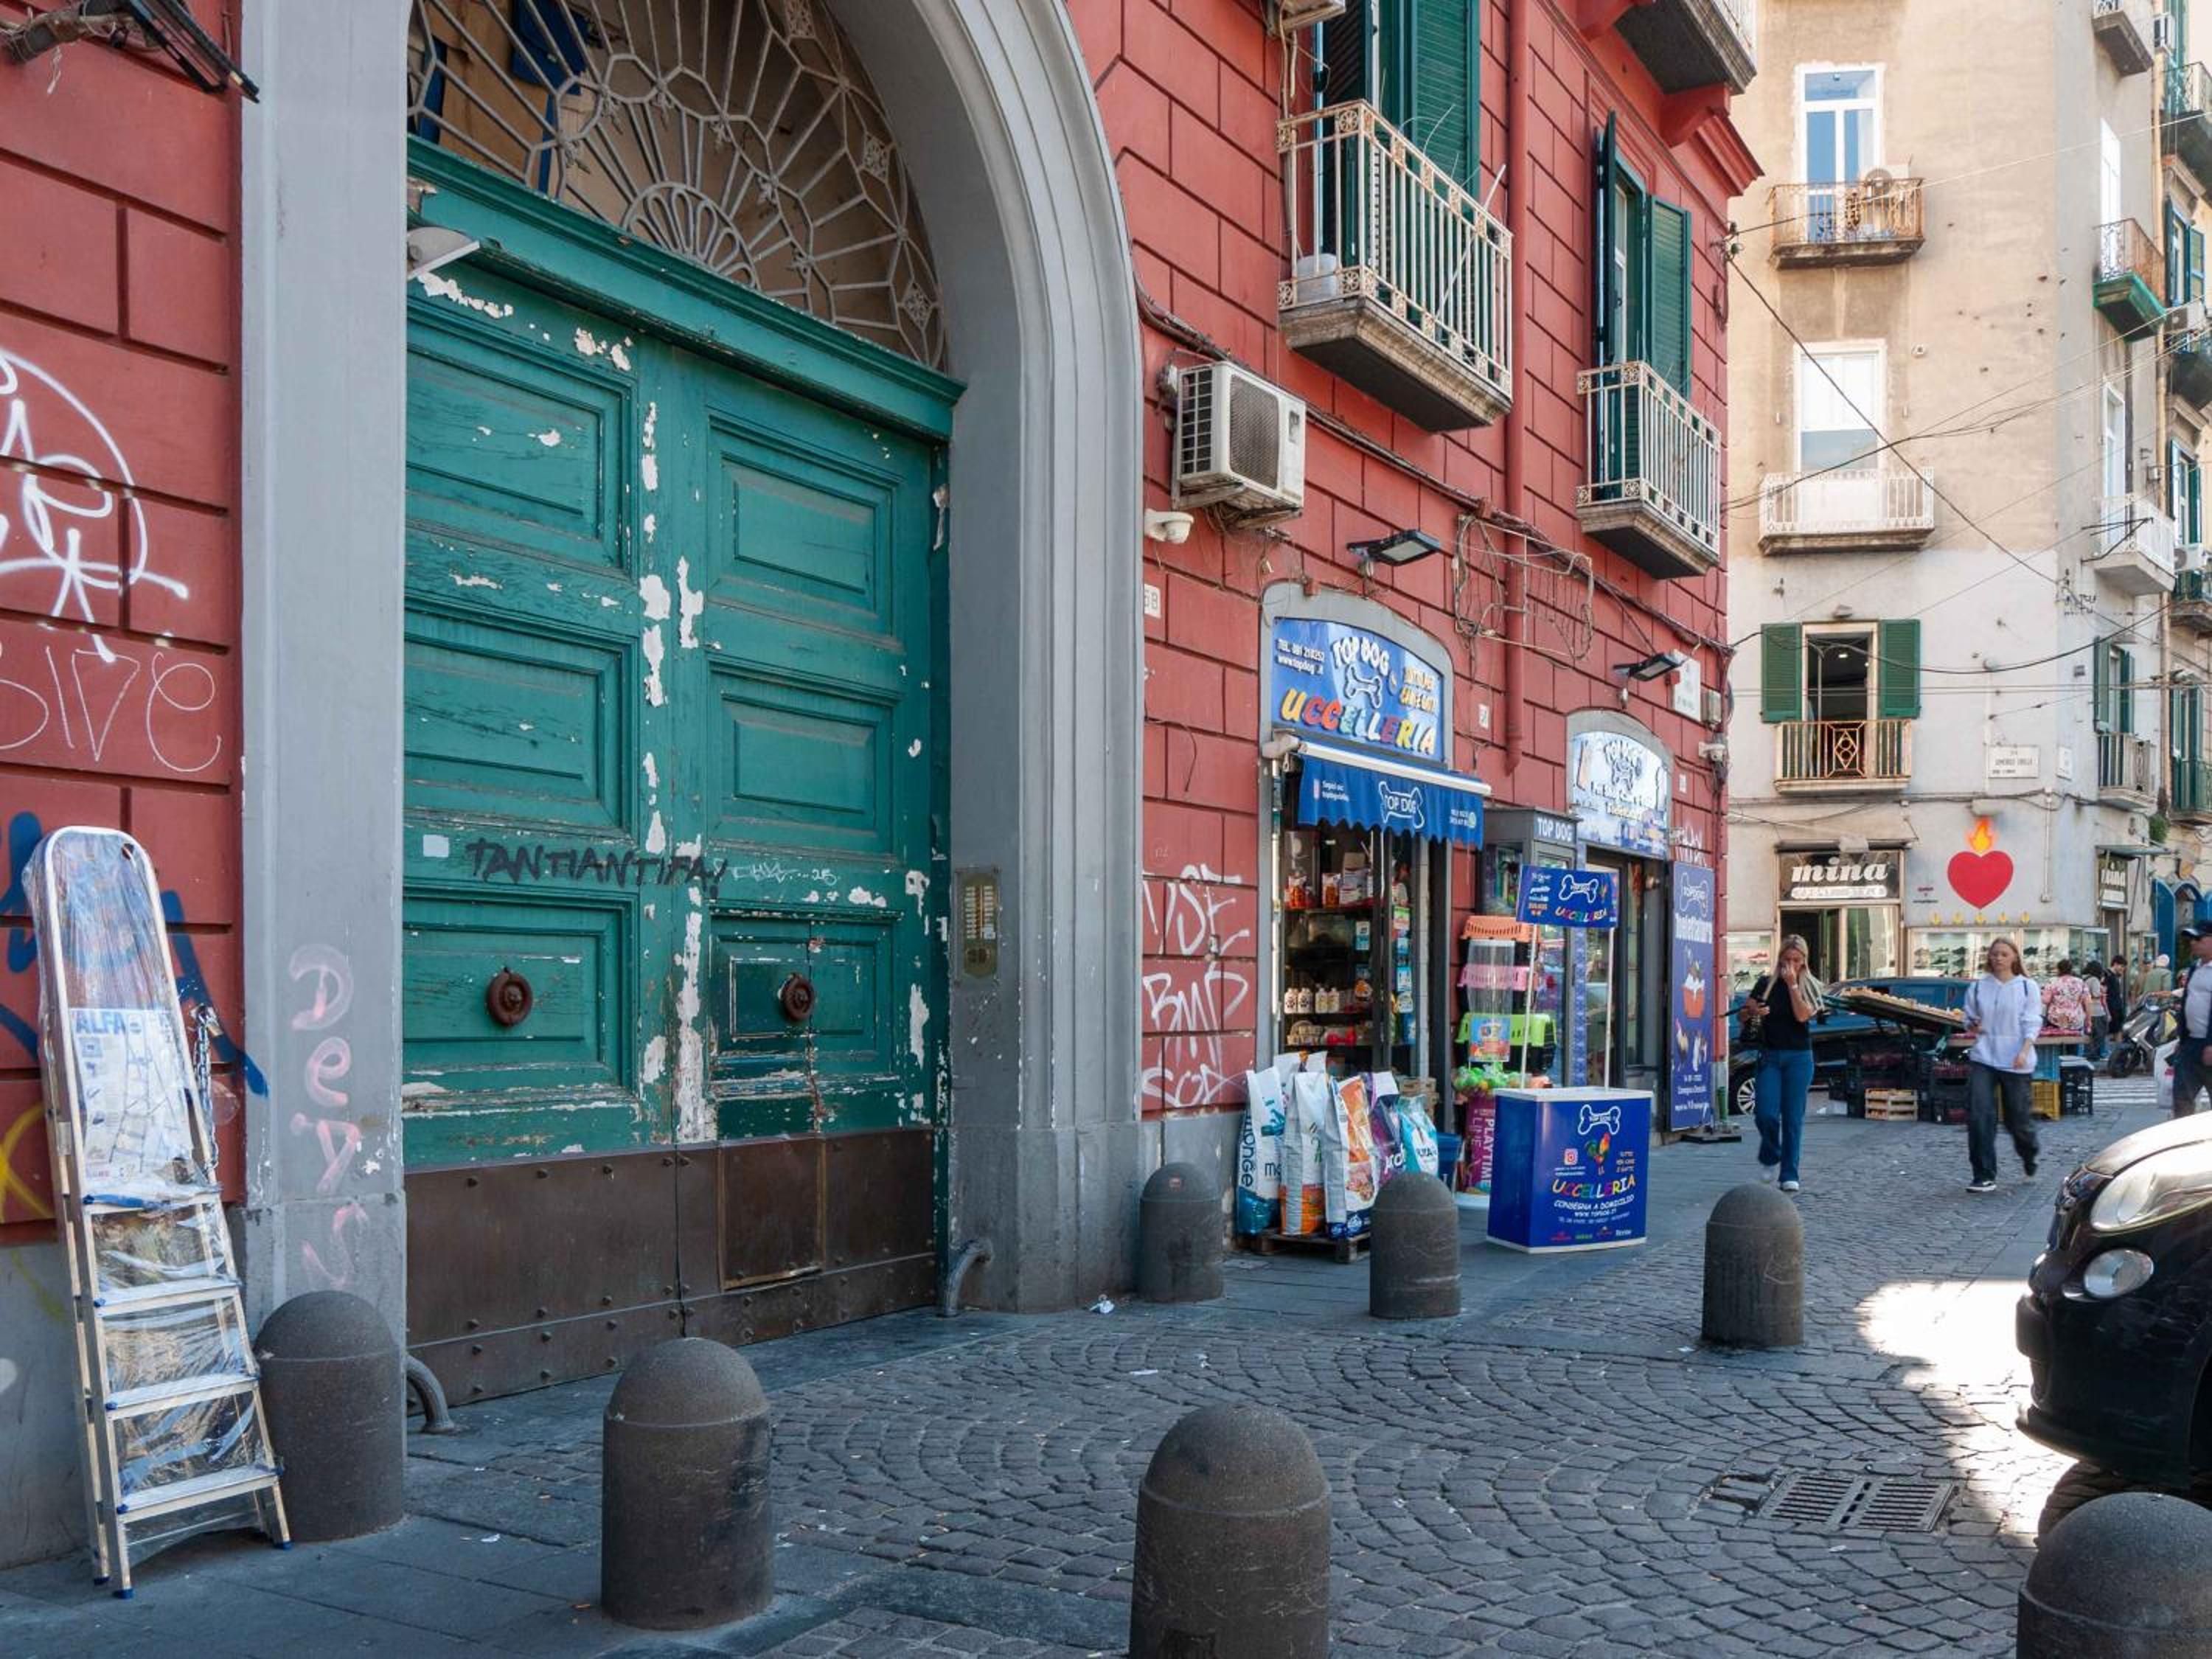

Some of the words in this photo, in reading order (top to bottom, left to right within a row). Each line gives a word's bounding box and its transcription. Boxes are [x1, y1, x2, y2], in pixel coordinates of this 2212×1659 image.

[1332, 636, 1359, 669] TOP
[1360, 636, 1390, 676] DOG
[1280, 688, 1437, 755] UCCELLERIA
[1537, 817, 1553, 837] TOP
[1555, 821, 1572, 842] DOG
[1791, 857, 1889, 883] mina
[1555, 906, 1607, 922] UCCELLERIA
[1552, 1173, 1636, 1199] UCCELLERIA
[1554, 1199, 1593, 1211] CONSEGNA
[1600, 1194, 1635, 1210] DOMICILIO
